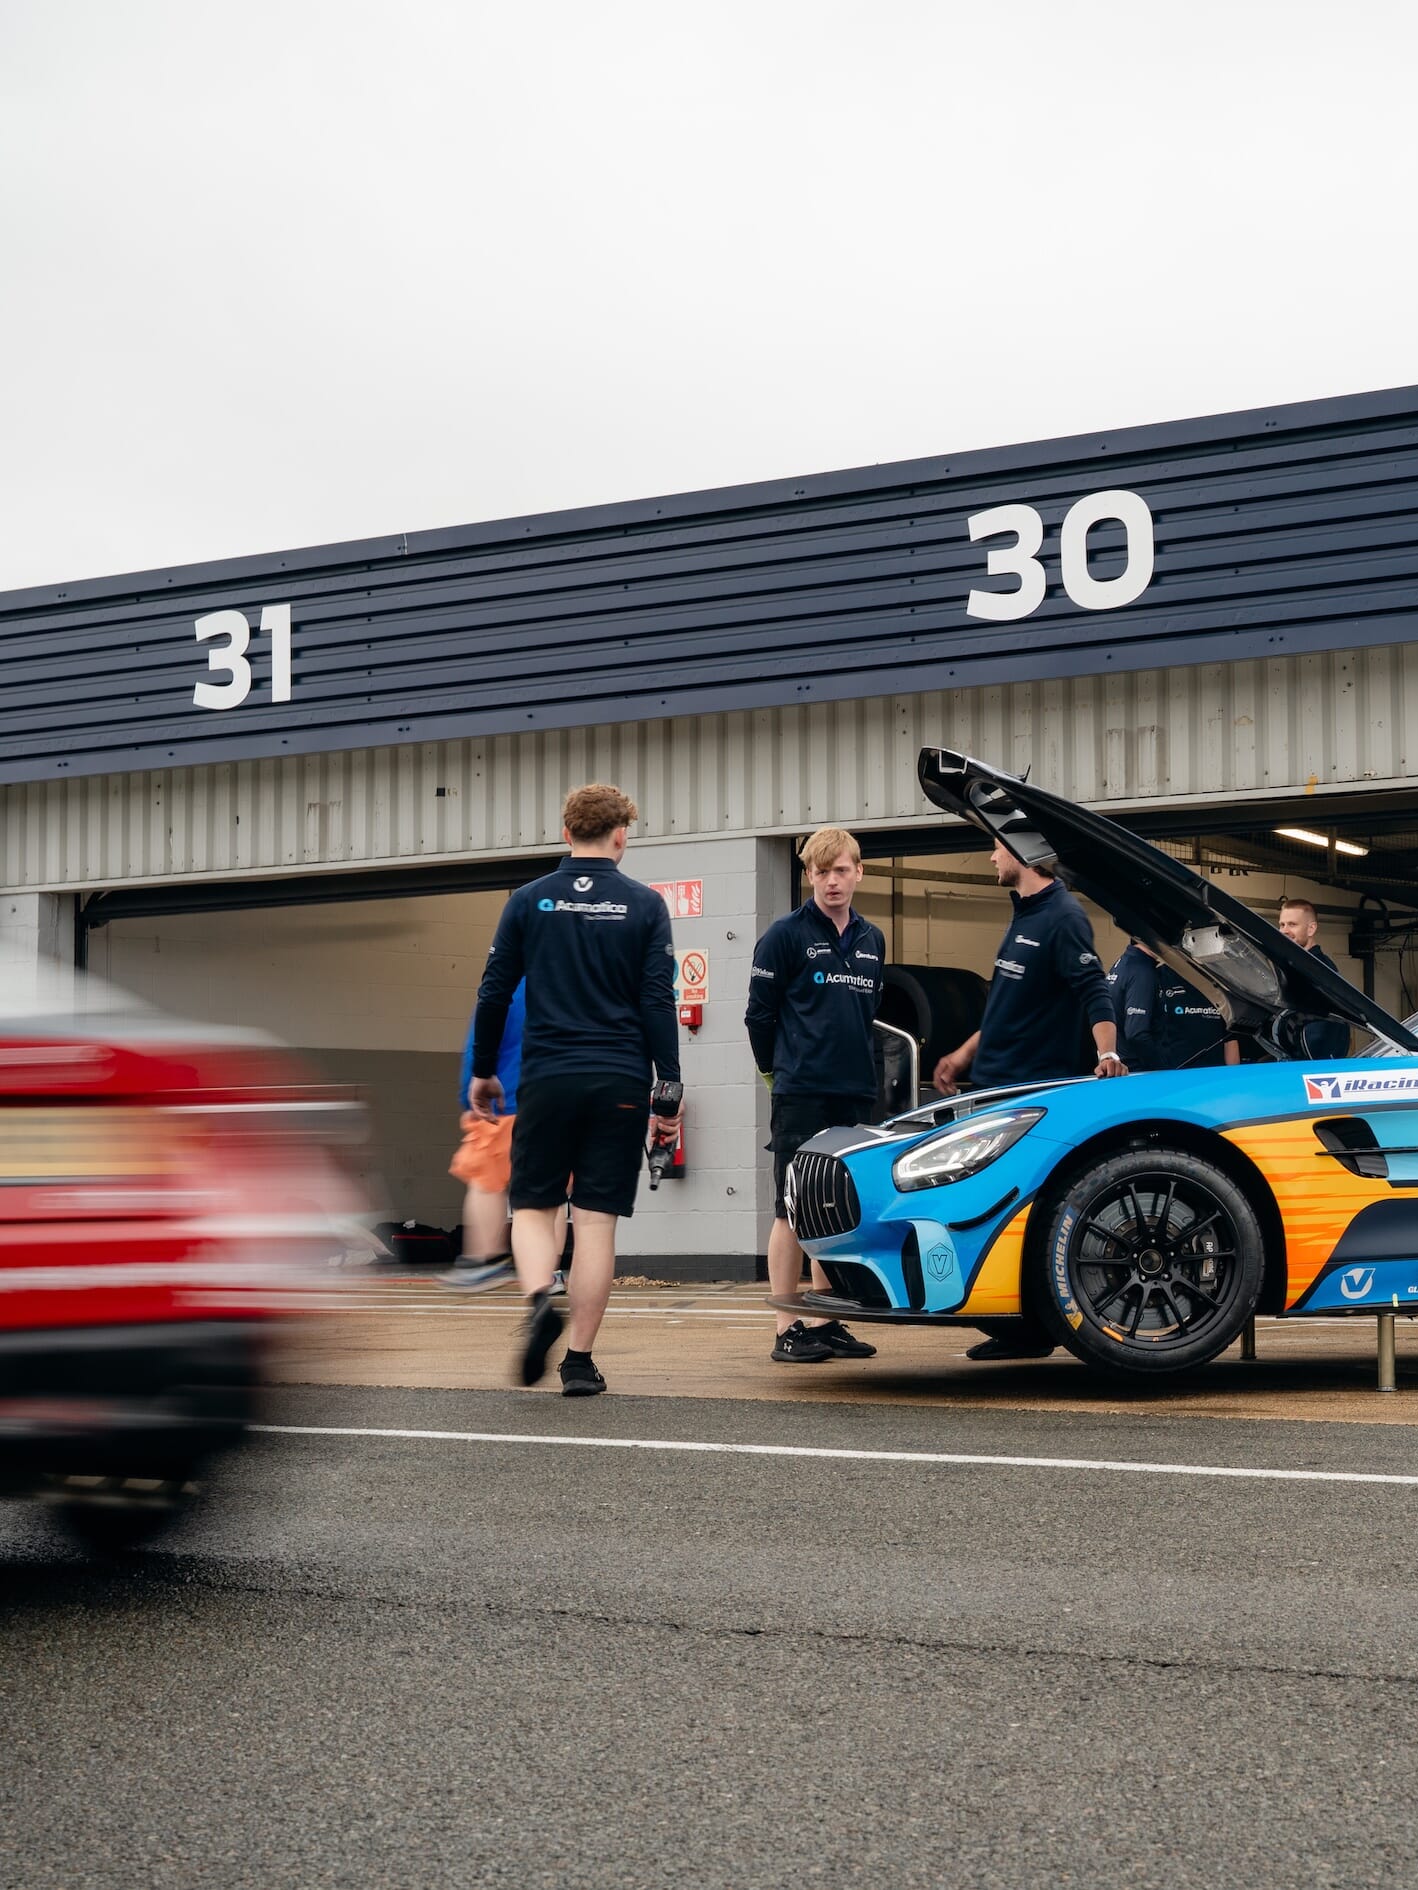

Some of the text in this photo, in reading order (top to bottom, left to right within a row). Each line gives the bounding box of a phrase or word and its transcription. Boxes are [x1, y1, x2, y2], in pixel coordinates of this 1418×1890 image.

[966, 489, 1154, 621] 30
[193, 603, 291, 711] 31
[825, 972, 874, 988] Acumatica
[1055, 1214, 1074, 1298] MICHELIN
